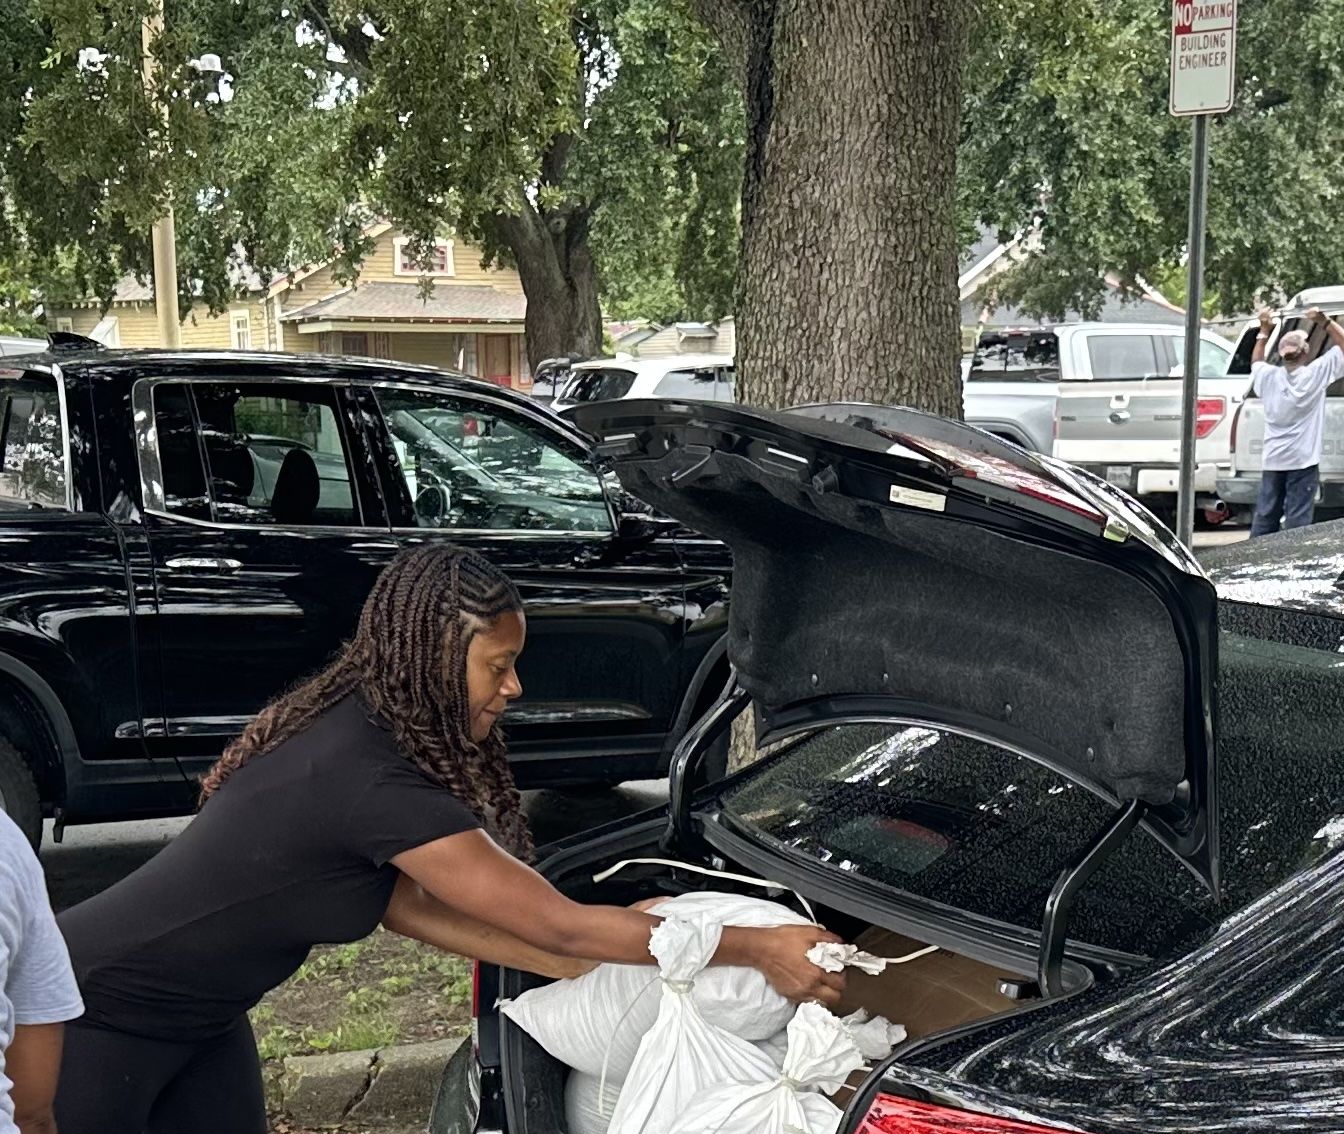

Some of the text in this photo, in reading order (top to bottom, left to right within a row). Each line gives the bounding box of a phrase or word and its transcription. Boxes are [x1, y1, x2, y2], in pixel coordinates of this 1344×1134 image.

[1175, 3, 1232, 26] NO PARKING
[1181, 33, 1226, 51] BUILDING
[1179, 52, 1227, 70] ENGINEER
